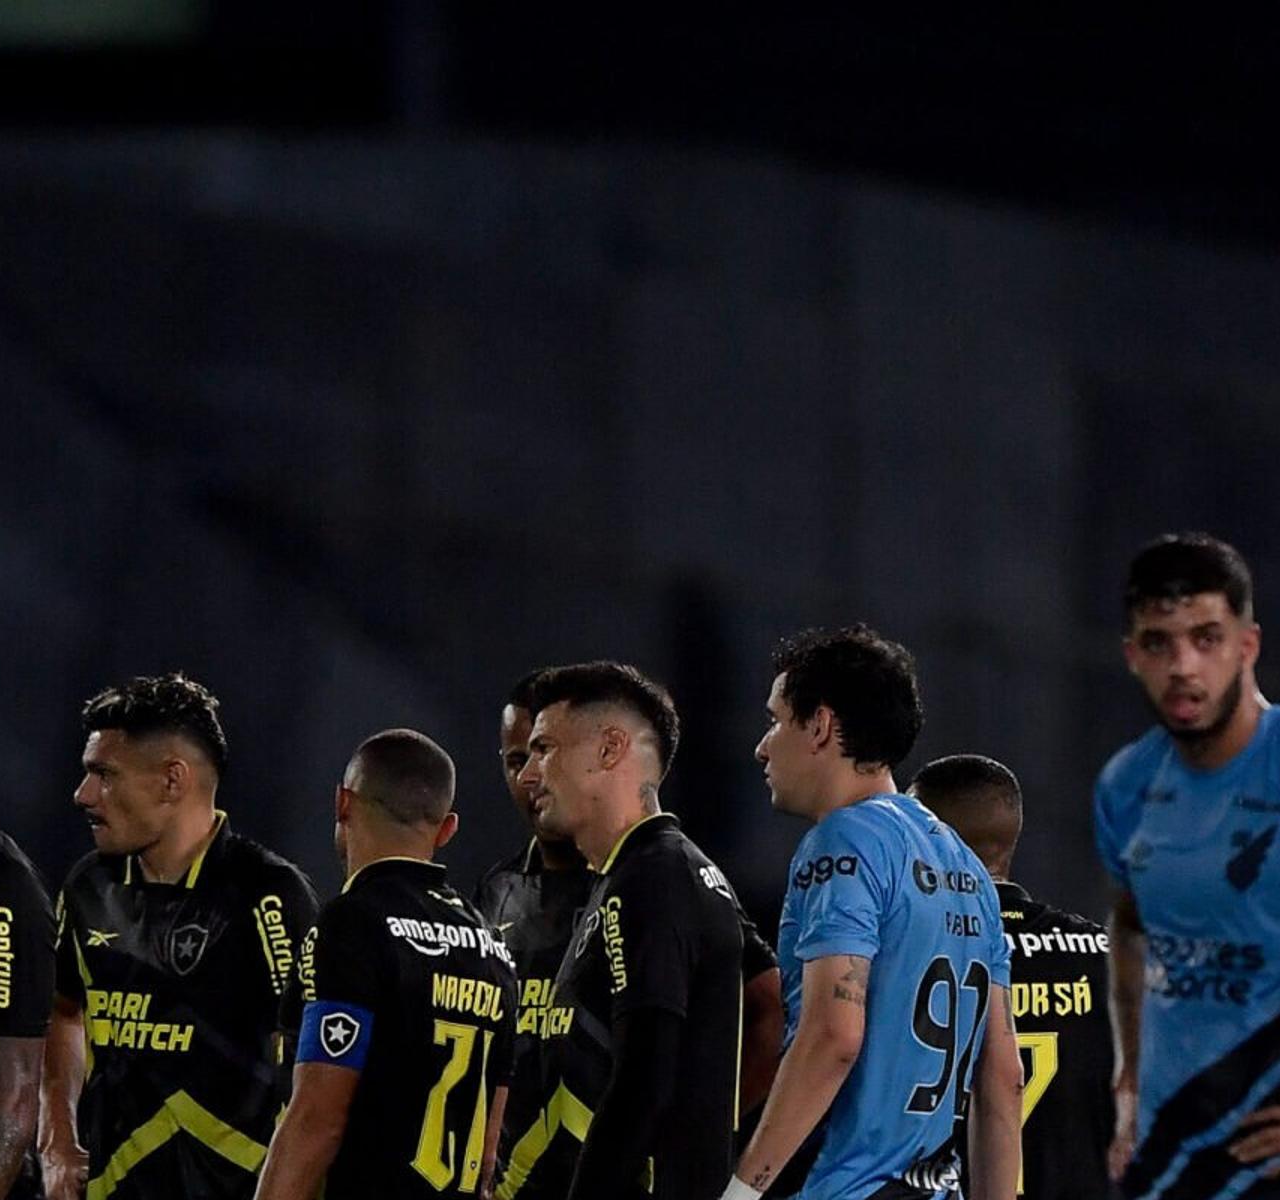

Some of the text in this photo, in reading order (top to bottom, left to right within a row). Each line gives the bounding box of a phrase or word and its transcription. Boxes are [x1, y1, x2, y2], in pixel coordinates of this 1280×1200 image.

[385, 915, 477, 949] amazon
[1019, 926, 1111, 959] prime
[87, 988, 153, 1021] PARI
[1052, 974, 1093, 1017] SÁ
[515, 1007, 575, 1041] ATCH
[904, 956, 992, 1121] 92
[409, 1018, 496, 1194] 21
